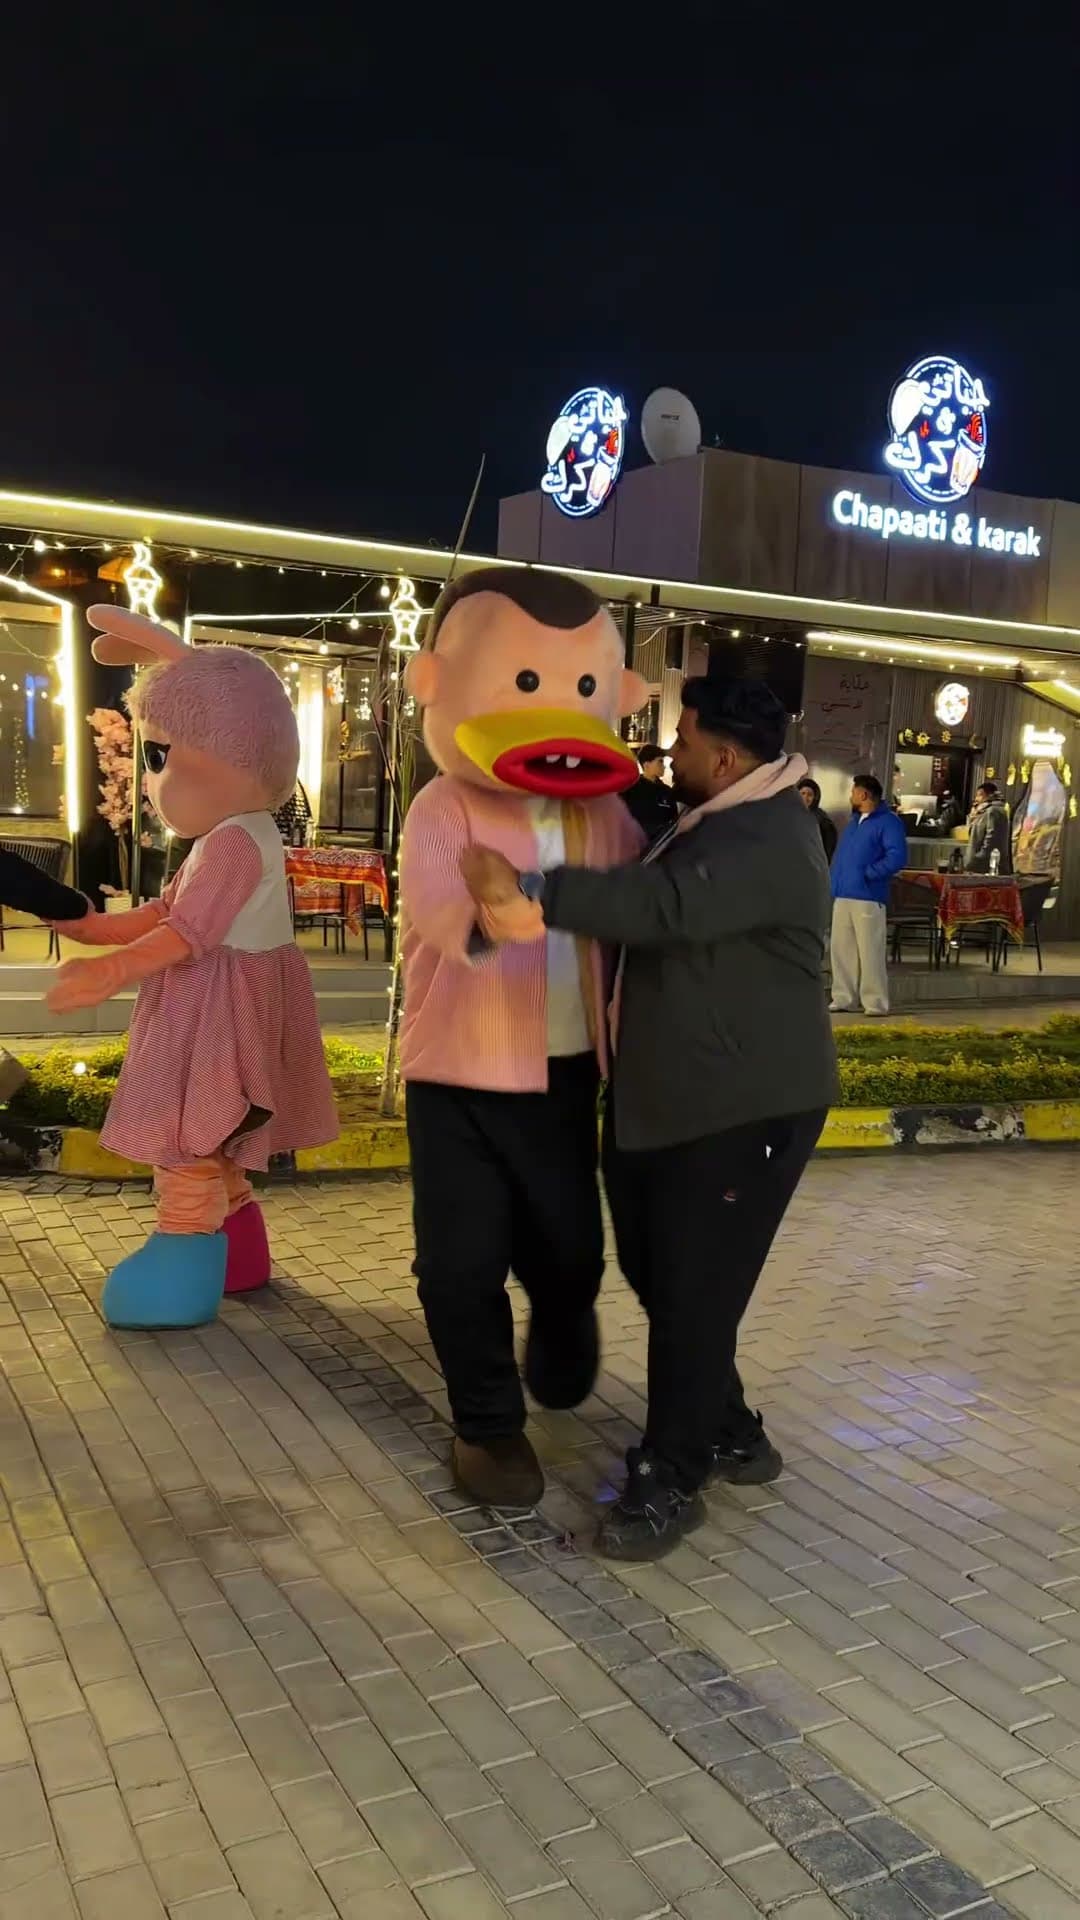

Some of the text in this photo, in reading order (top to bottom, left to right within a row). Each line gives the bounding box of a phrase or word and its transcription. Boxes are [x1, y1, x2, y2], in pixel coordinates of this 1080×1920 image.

[832, 490, 1042, 557] Chapaati & karak
